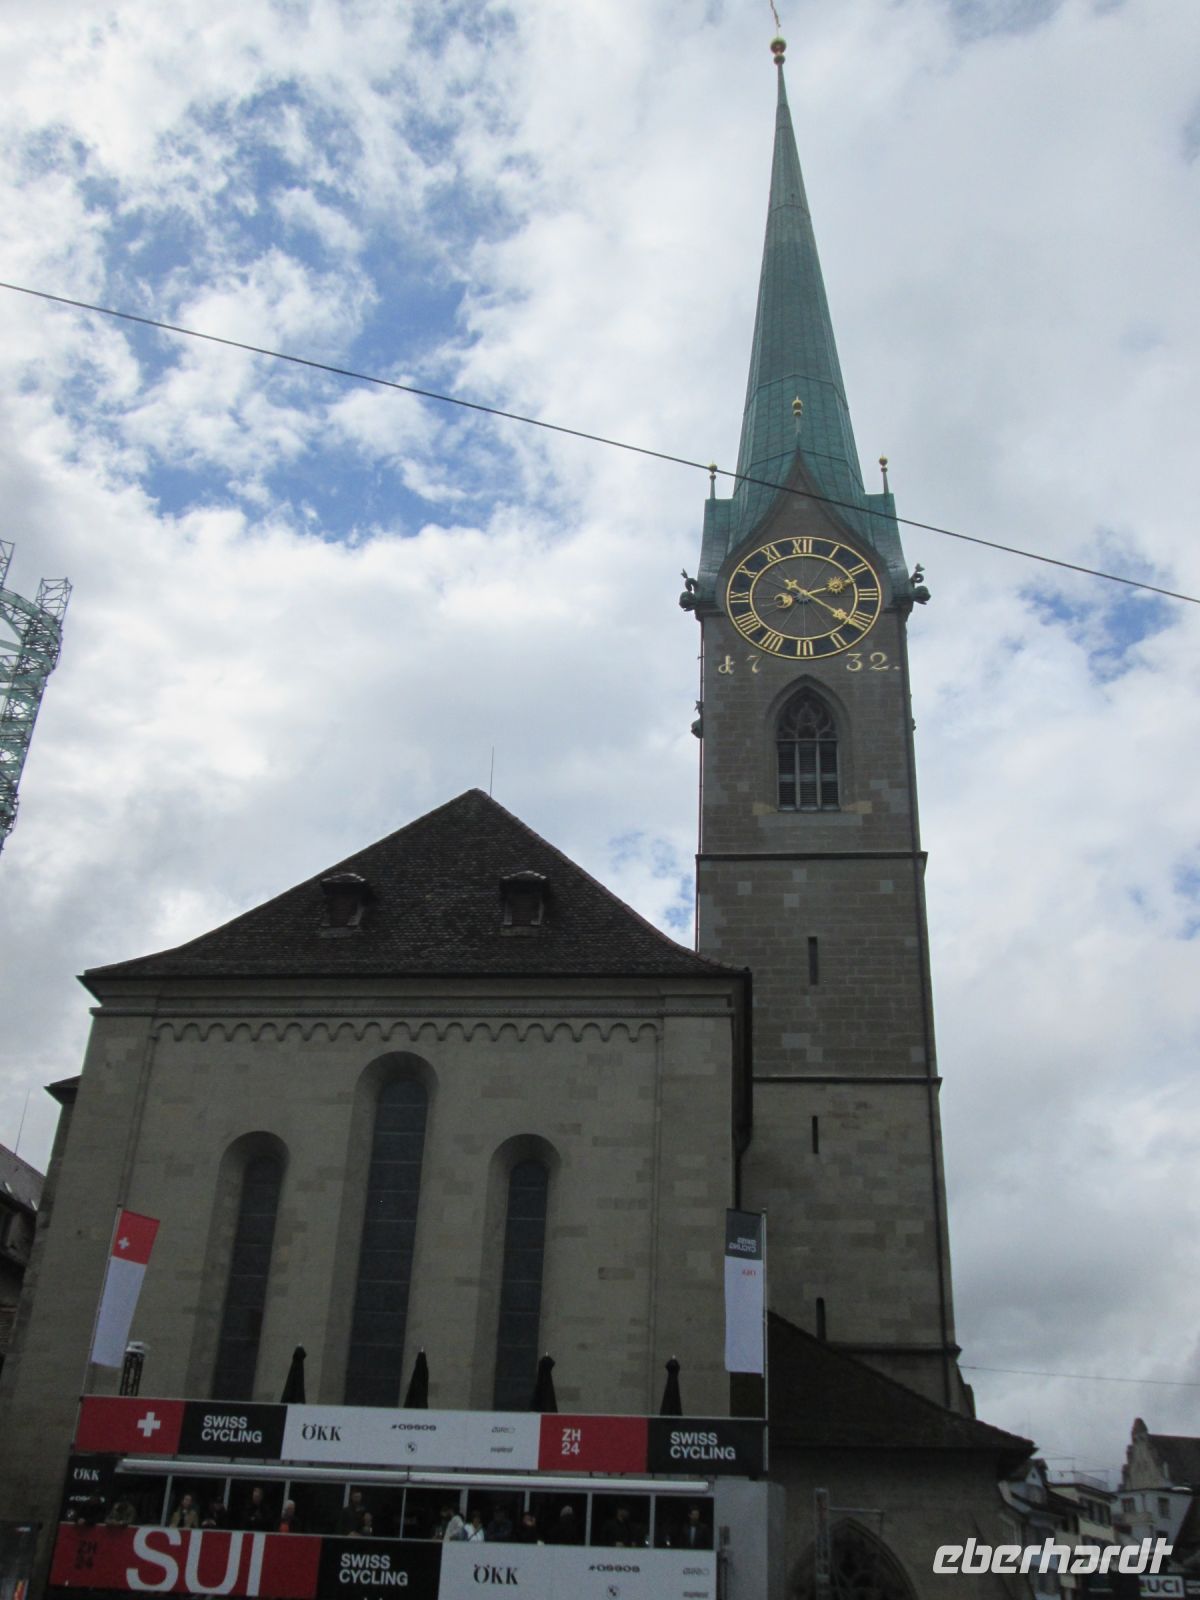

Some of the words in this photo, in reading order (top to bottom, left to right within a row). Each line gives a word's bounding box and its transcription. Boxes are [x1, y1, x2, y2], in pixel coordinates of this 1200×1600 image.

[761, 545, 781, 562] XI
[792, 539, 813, 554] XII
[738, 565, 757, 578] X
[858, 588, 878, 600] III
[203, 1415, 248, 1429] SWISS
[201, 1429, 263, 1443] CYCLING
[561, 1428, 581, 1442] ZH
[670, 1432, 718, 1446] SWISS
[561, 1442, 581, 1455] 24
[670, 1445, 736, 1460] CYCLING
[126, 1527, 266, 1596] SUI
[340, 1553, 391, 1569] SWISS
[339, 1569, 408, 1586] CYCLING
[473, 1563, 519, 1585] ÖKK
[1148, 1579, 1180, 1593] UCI
